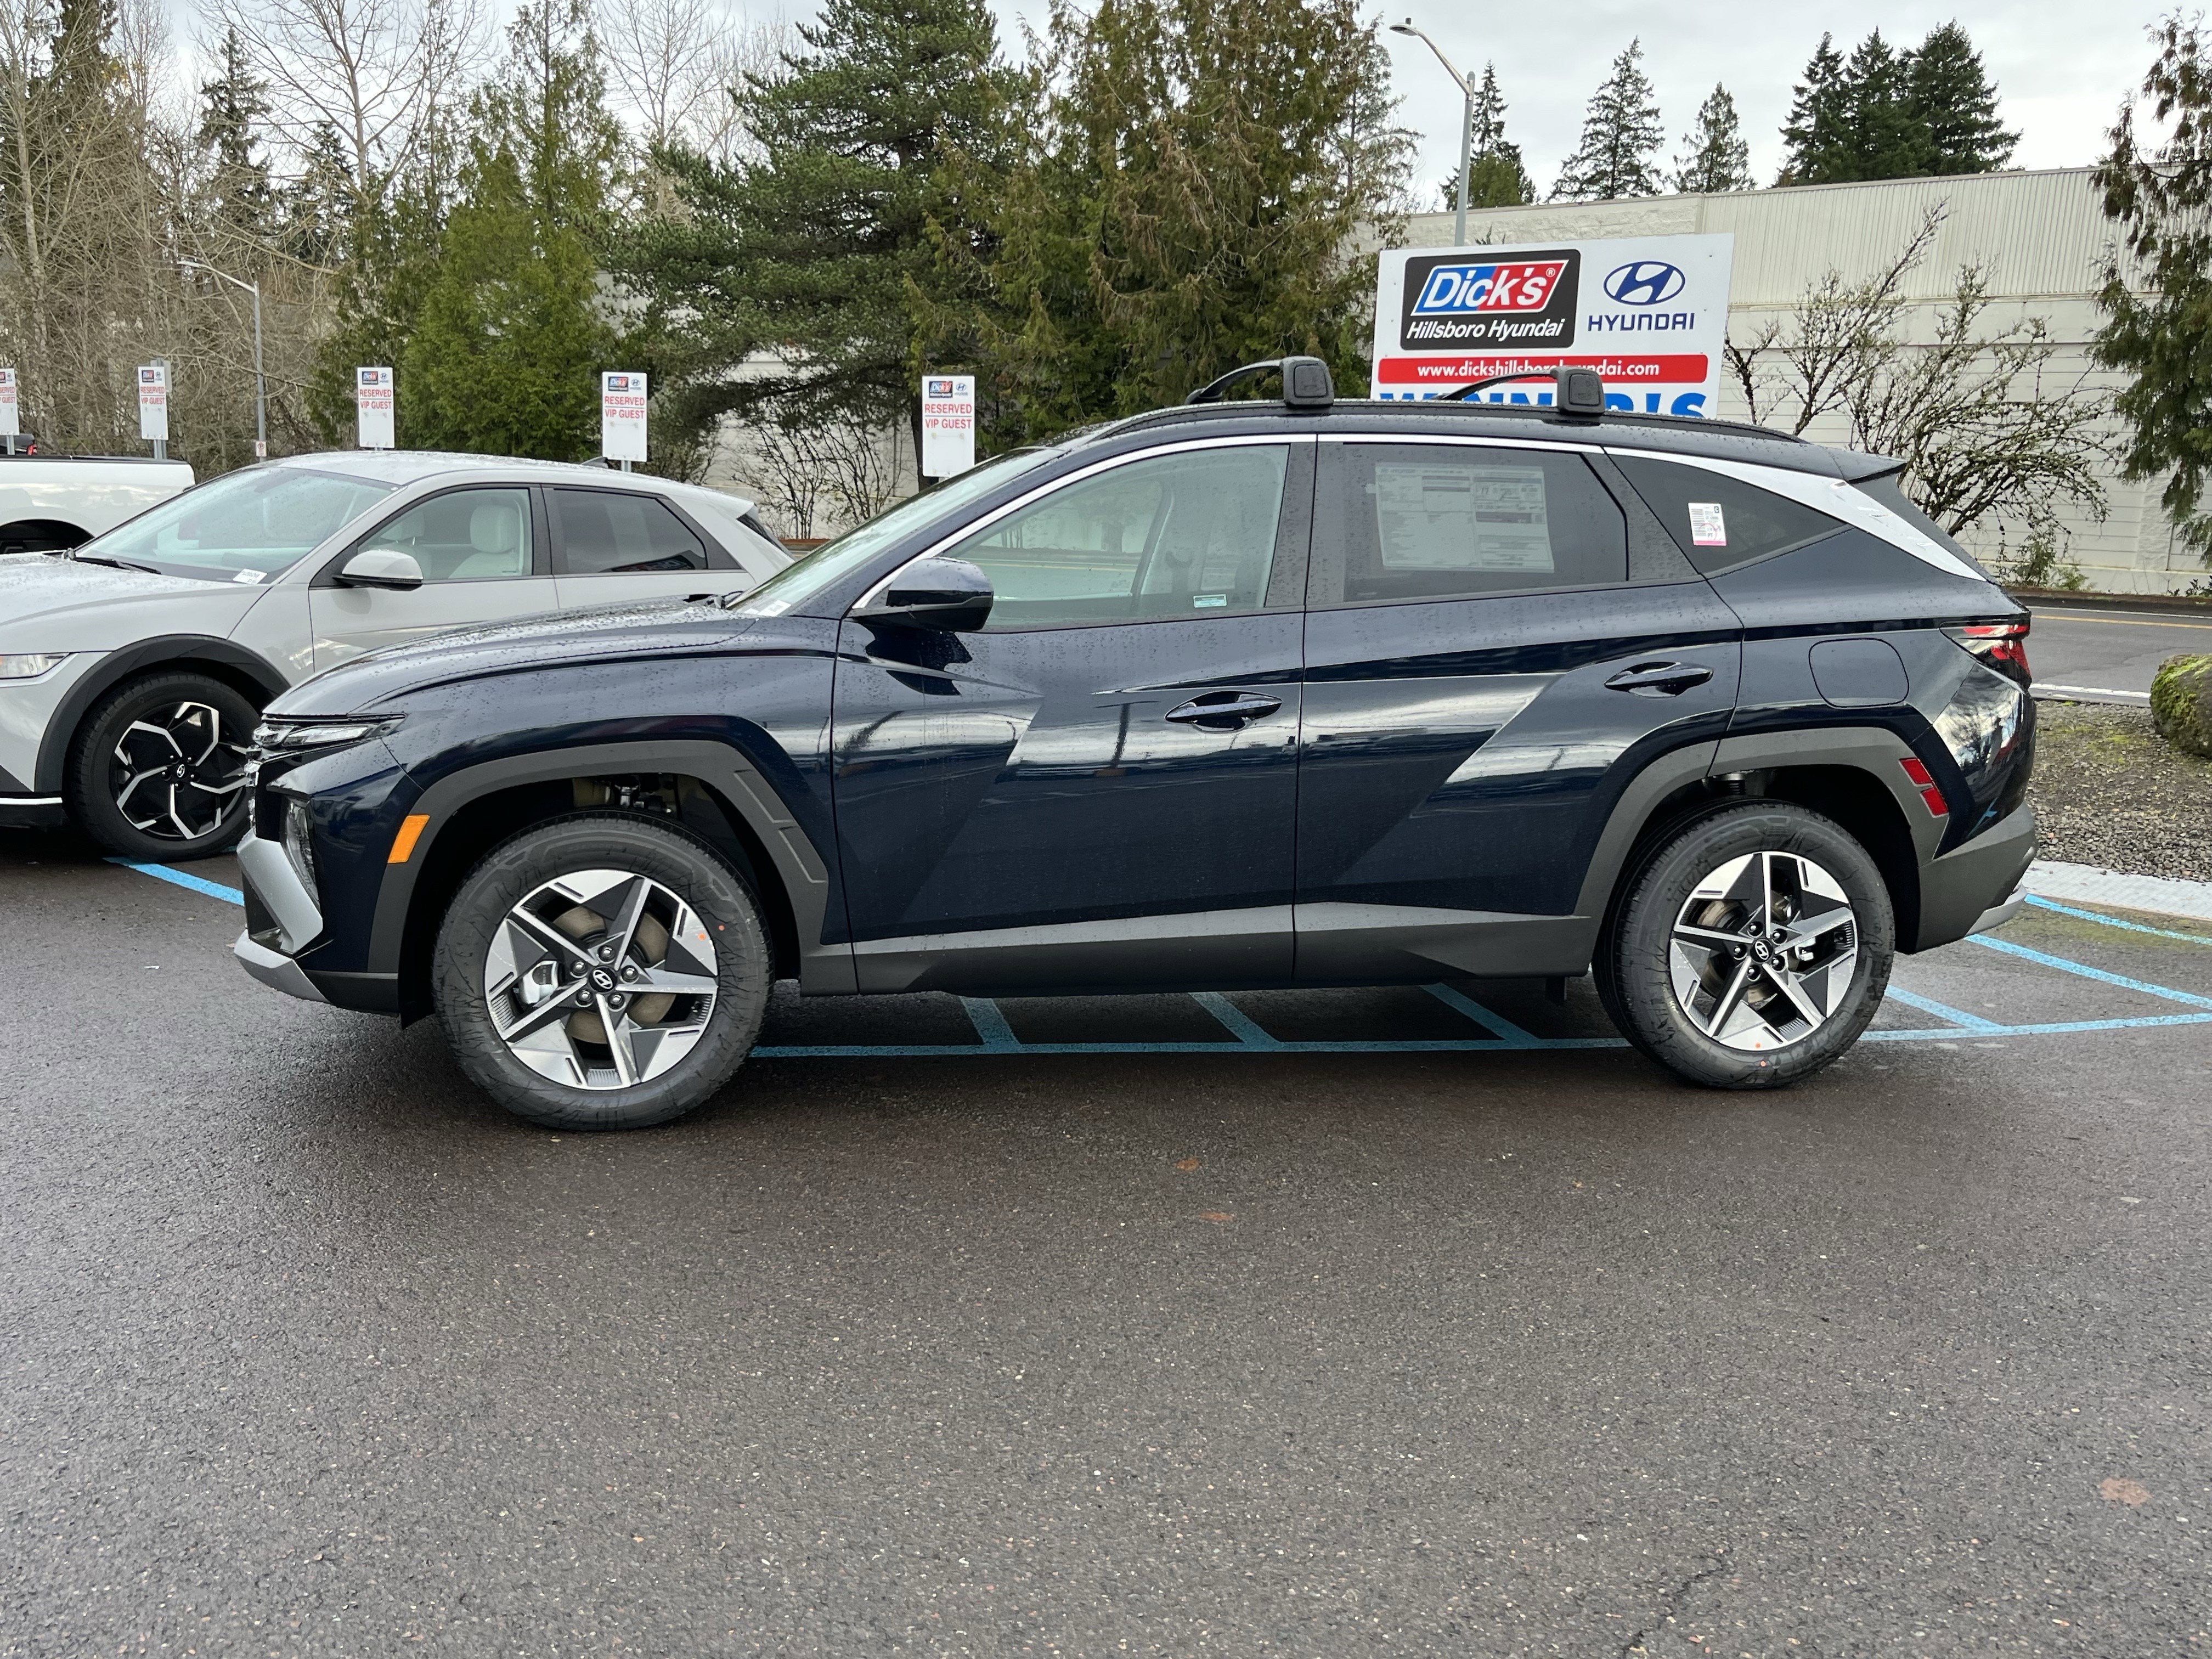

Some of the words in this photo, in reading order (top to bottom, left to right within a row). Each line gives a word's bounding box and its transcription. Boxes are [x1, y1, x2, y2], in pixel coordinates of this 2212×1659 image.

[1423, 267, 1547, 309] Dick's
[1588, 312, 1695, 331] HYUNDAI
[1406, 320, 1486, 340] Hillsboro
[1487, 318, 1566, 342] Hyundai
[1417, 359, 1660, 377] www.dickshillsborndai.com
[359, 389, 392, 397] RESERVED
[371, 401, 392, 409] GUEST
[605, 396, 645, 406] RESERVED
[605, 409, 617, 417] VIP
[619, 409, 645, 419] GUEST
[924, 403, 972, 414] RESERVED
[924, 418, 939, 428] VIP
[941, 419, 972, 429] GUEST
